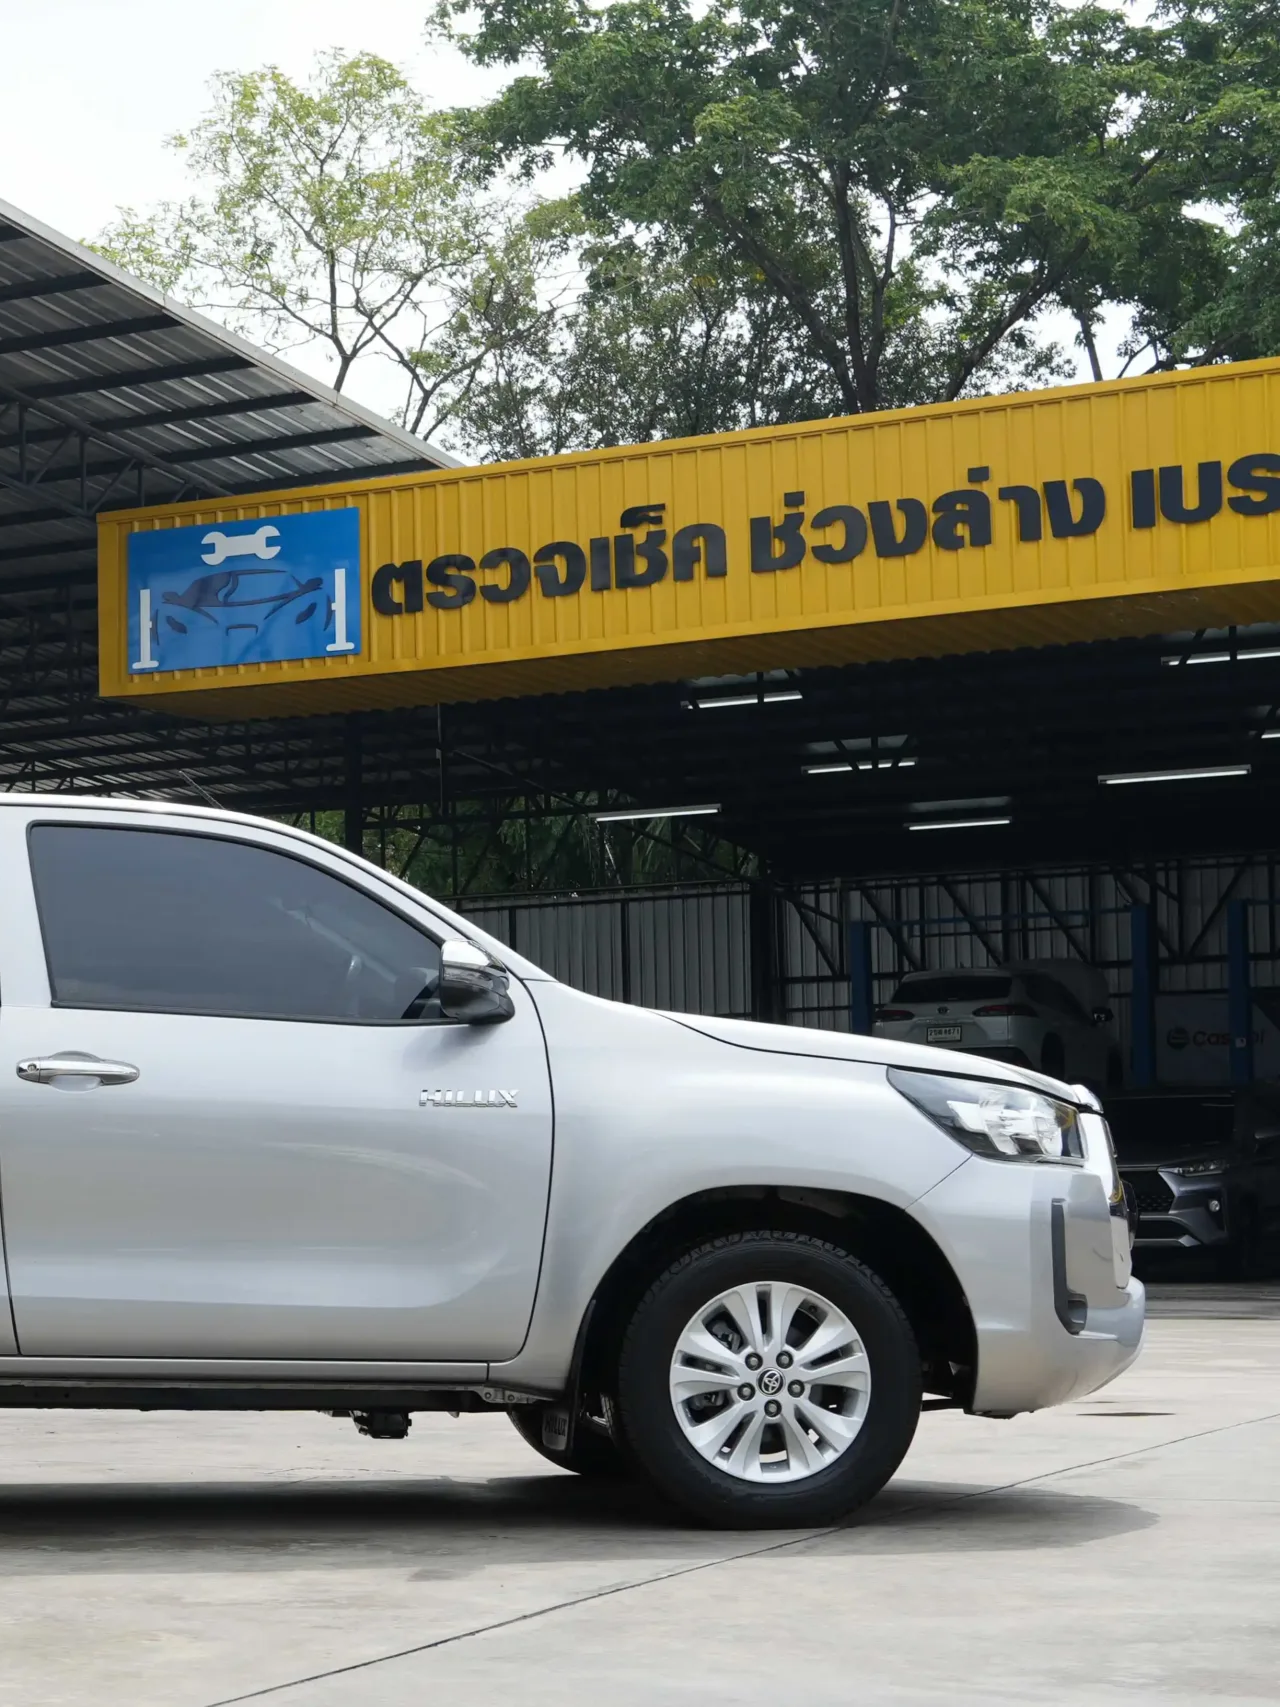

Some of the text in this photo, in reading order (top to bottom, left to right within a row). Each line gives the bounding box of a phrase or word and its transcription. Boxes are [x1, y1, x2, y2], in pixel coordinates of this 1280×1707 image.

[371, 503, 727, 615] ตรวจเช็ค
[750, 466, 1106, 574] ช่วงล่าง
[419, 1089, 519, 1107] HILUX
